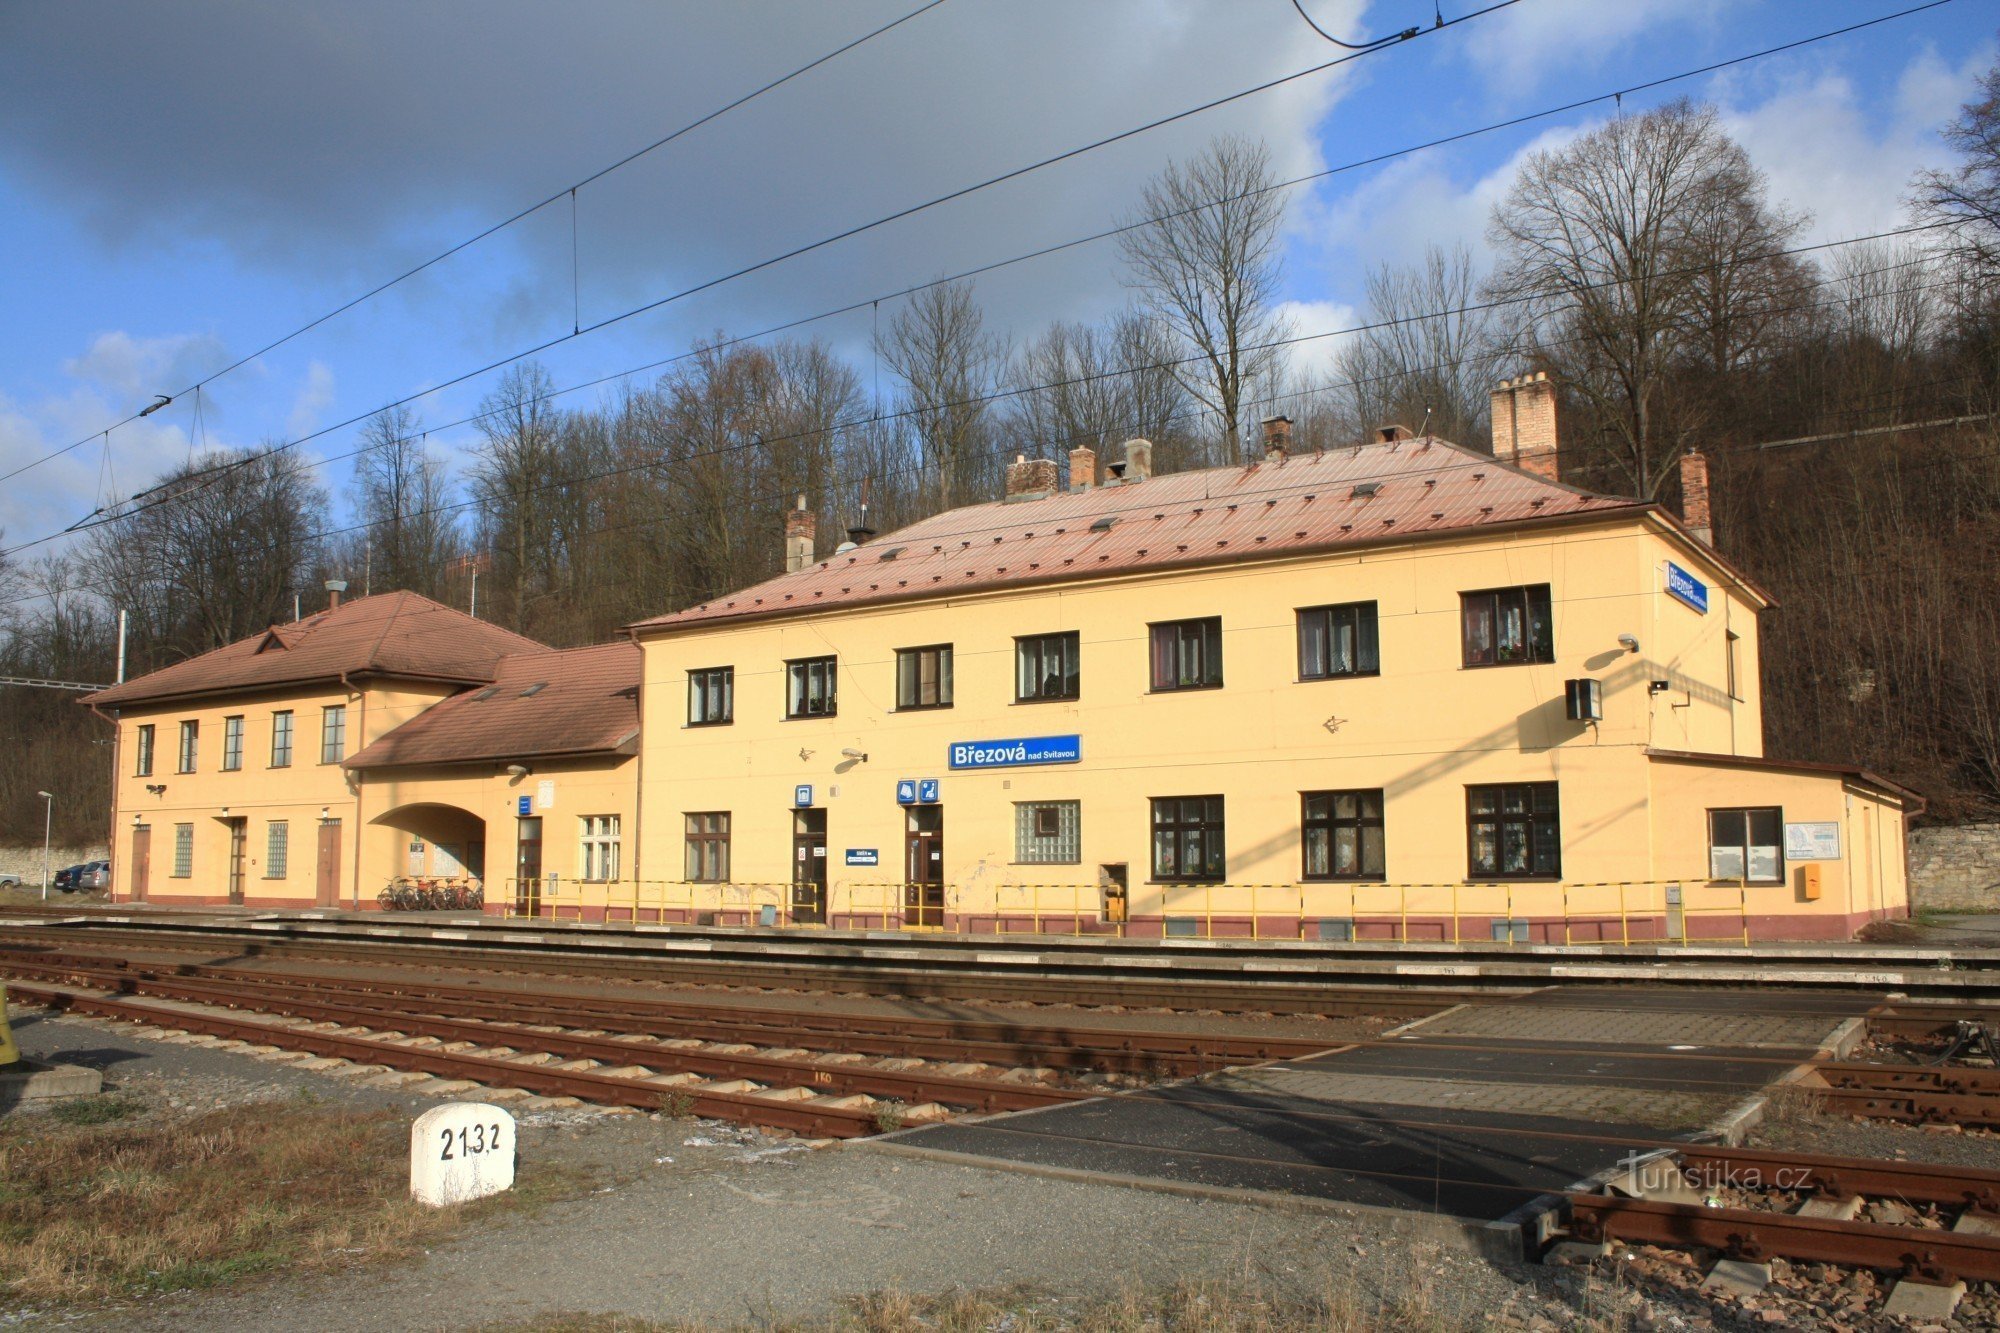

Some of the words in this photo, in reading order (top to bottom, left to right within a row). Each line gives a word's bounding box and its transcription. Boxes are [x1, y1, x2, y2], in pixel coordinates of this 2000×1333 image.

[955, 743, 1026, 764] Březová
[1028, 752, 1042, 760] nad
[1043, 751, 1075, 759] Svitavou
[441, 1123, 500, 1161] 213,2
